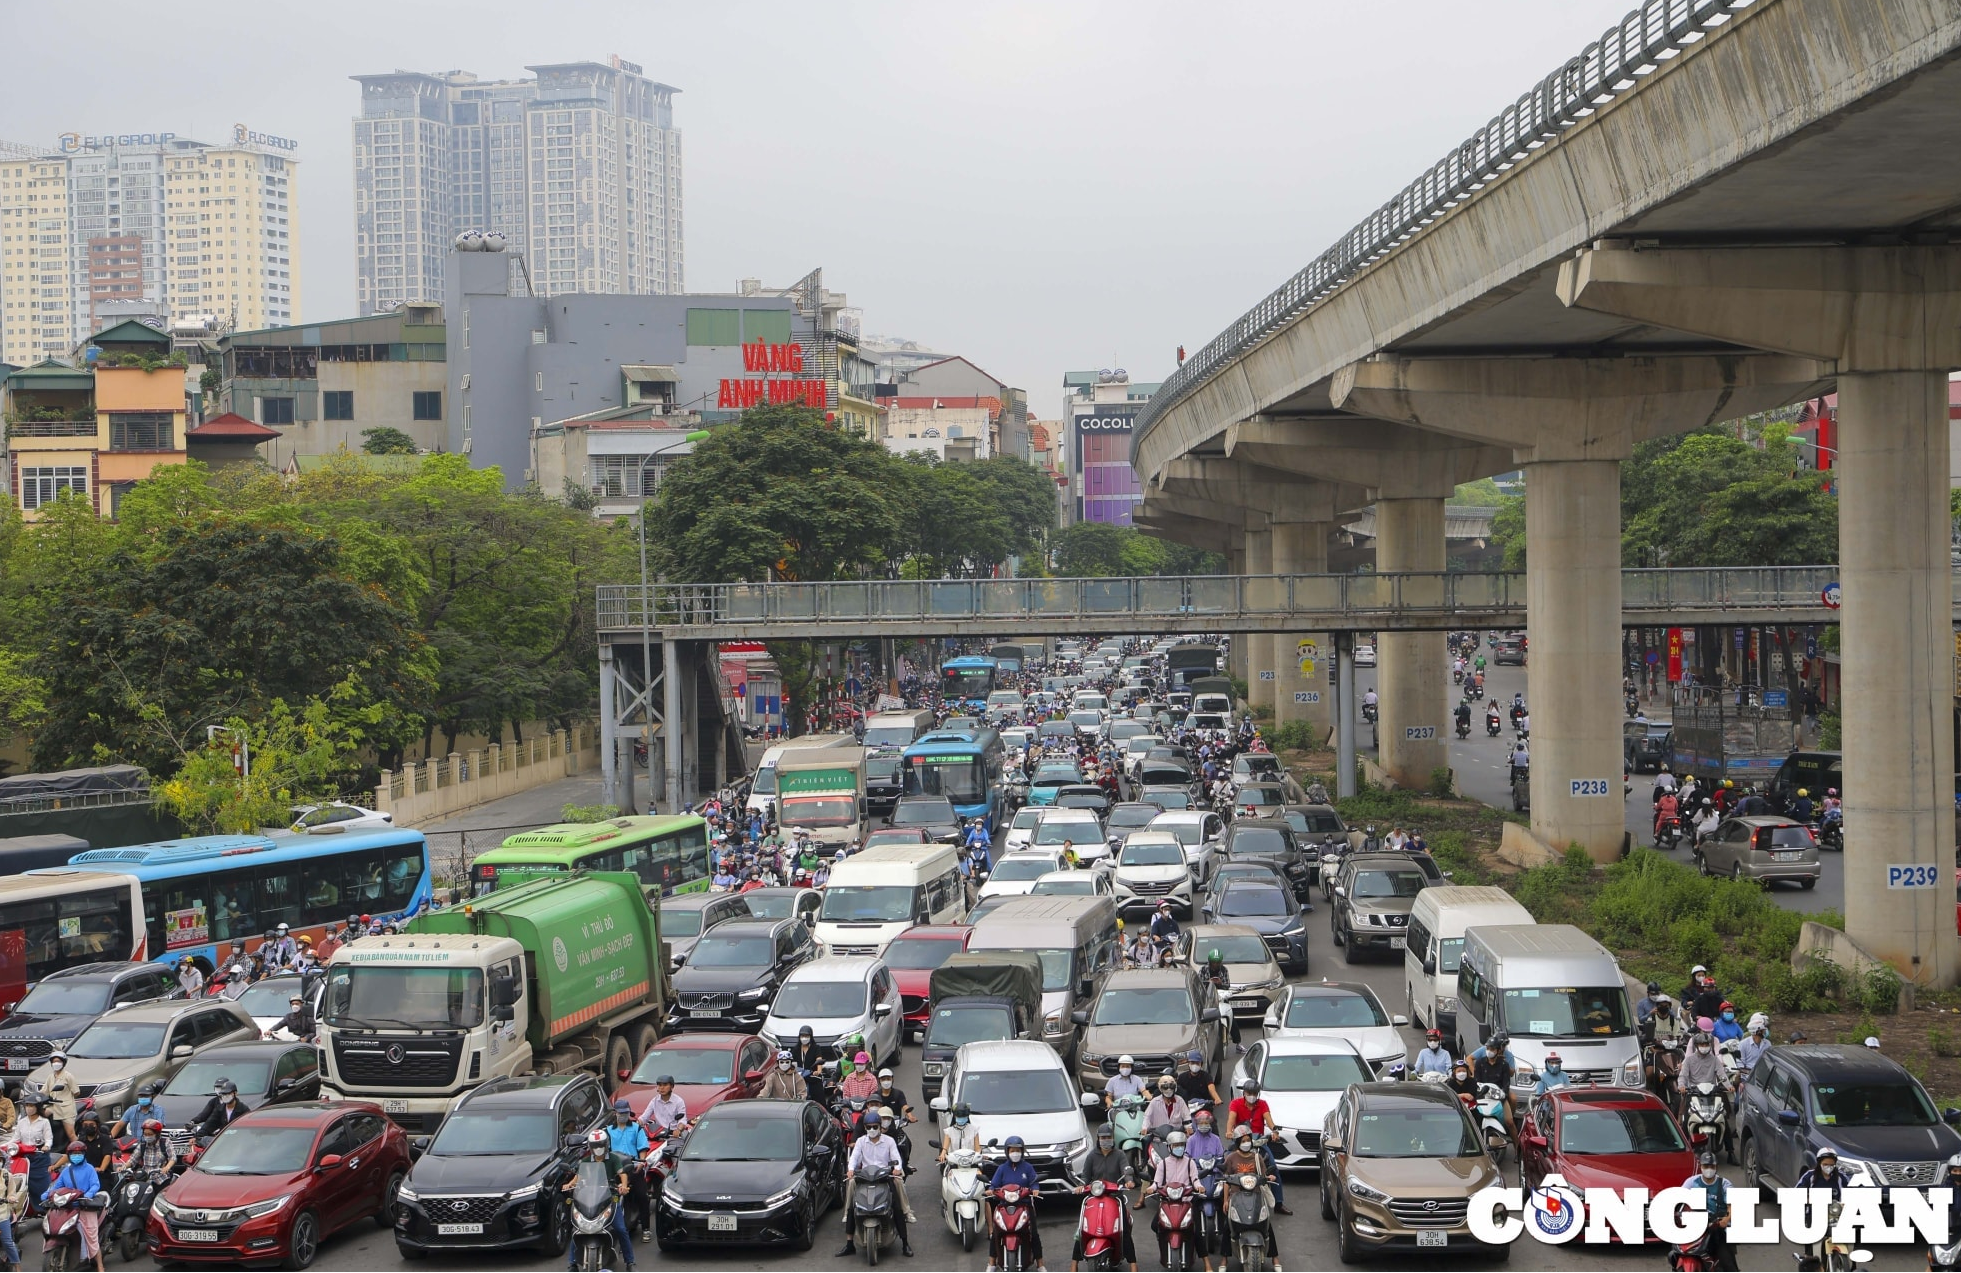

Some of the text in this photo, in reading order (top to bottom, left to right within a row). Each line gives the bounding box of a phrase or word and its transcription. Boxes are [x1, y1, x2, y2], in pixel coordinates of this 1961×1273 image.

[85, 132, 175, 149] FLC GROUP
[249, 131, 298, 151] FLC GROUP
[742, 336, 803, 372] VÀNG
[718, 379, 826, 408] ANH MINH
[1295, 692, 1319, 702] P236
[1406, 727, 1435, 739] P237
[1572, 780, 1608, 795] P238
[1889, 866, 1938, 887] P239
[590, 915, 604, 935] THỦ
[403, 953, 420, 961] NAM
[179, 1231, 217, 1240] 30G-319.55
[1420, 1238, 1444, 1246] 638.54
[1425, 1231, 1439, 1239] 30H
